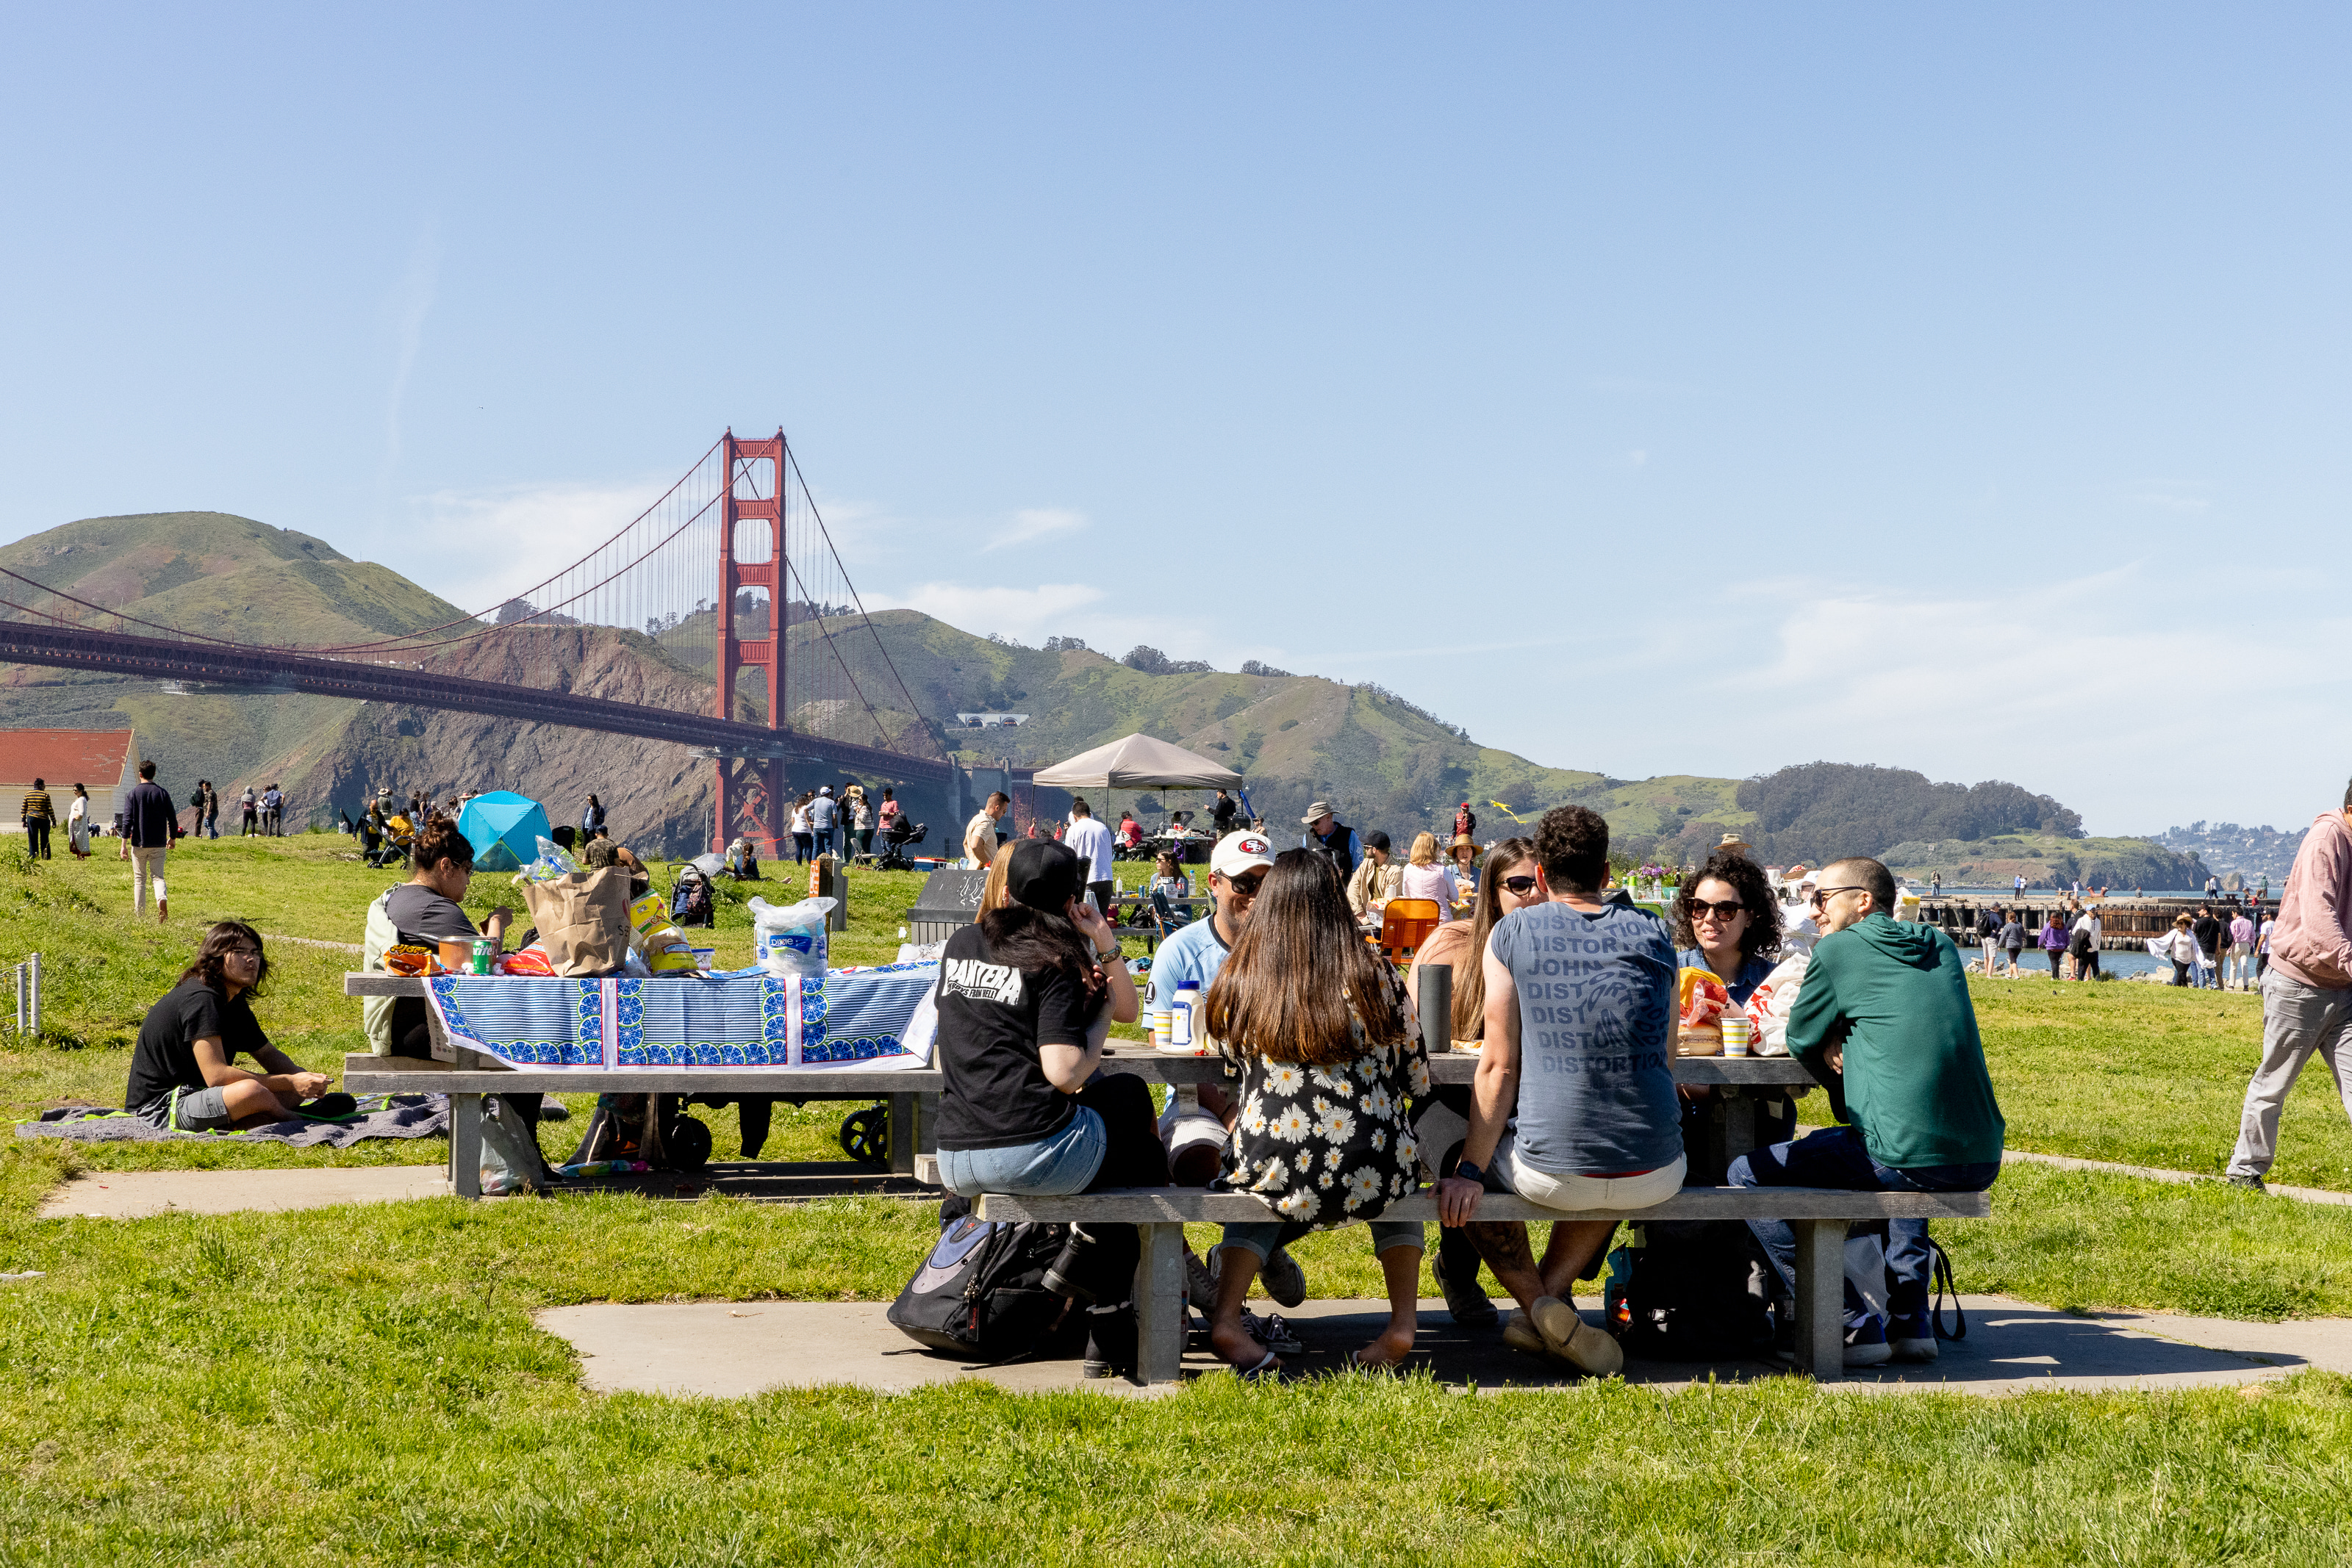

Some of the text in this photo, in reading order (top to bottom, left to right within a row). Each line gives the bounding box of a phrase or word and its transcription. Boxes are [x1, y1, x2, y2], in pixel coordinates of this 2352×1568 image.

[1246, 840, 1264, 852] SF
[1529, 916, 1656, 938] DISTOTION
[473, 944, 492, 955] rite
[1527, 959, 1605, 977] JOHN
[942, 958, 1022, 1005] PANTERA
[982, 989, 995, 999] HELL
